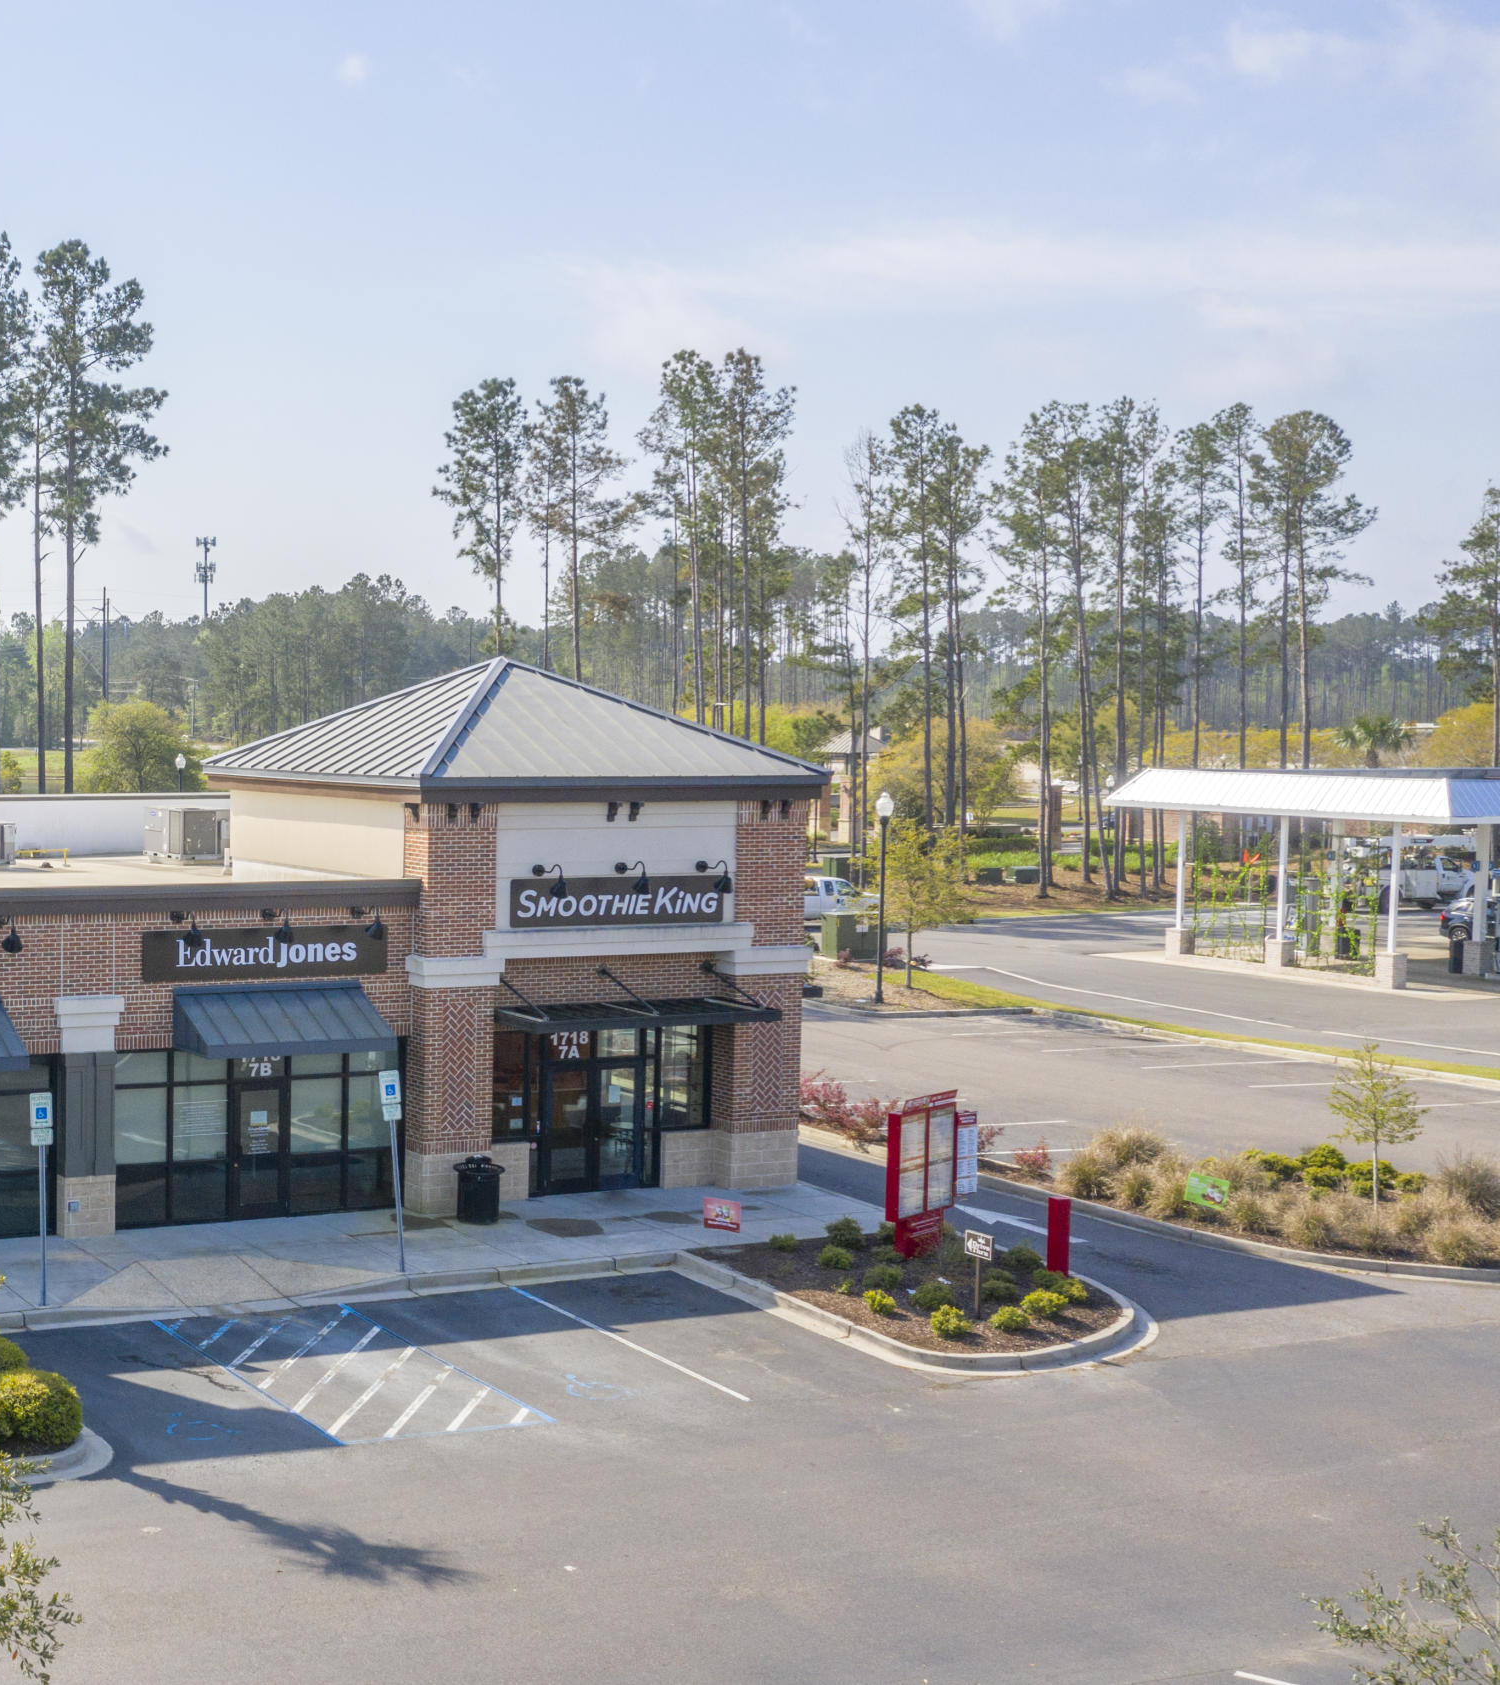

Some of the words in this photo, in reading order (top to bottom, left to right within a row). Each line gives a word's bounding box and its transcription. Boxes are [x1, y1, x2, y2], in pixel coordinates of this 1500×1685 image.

[516, 889, 652, 918] SMOOTHIE
[175, 937, 275, 968] Edward
[550, 1031, 589, 1046] 1718
[558, 1045, 580, 1059] 7A
[249, 1062, 273, 1077] 7B
